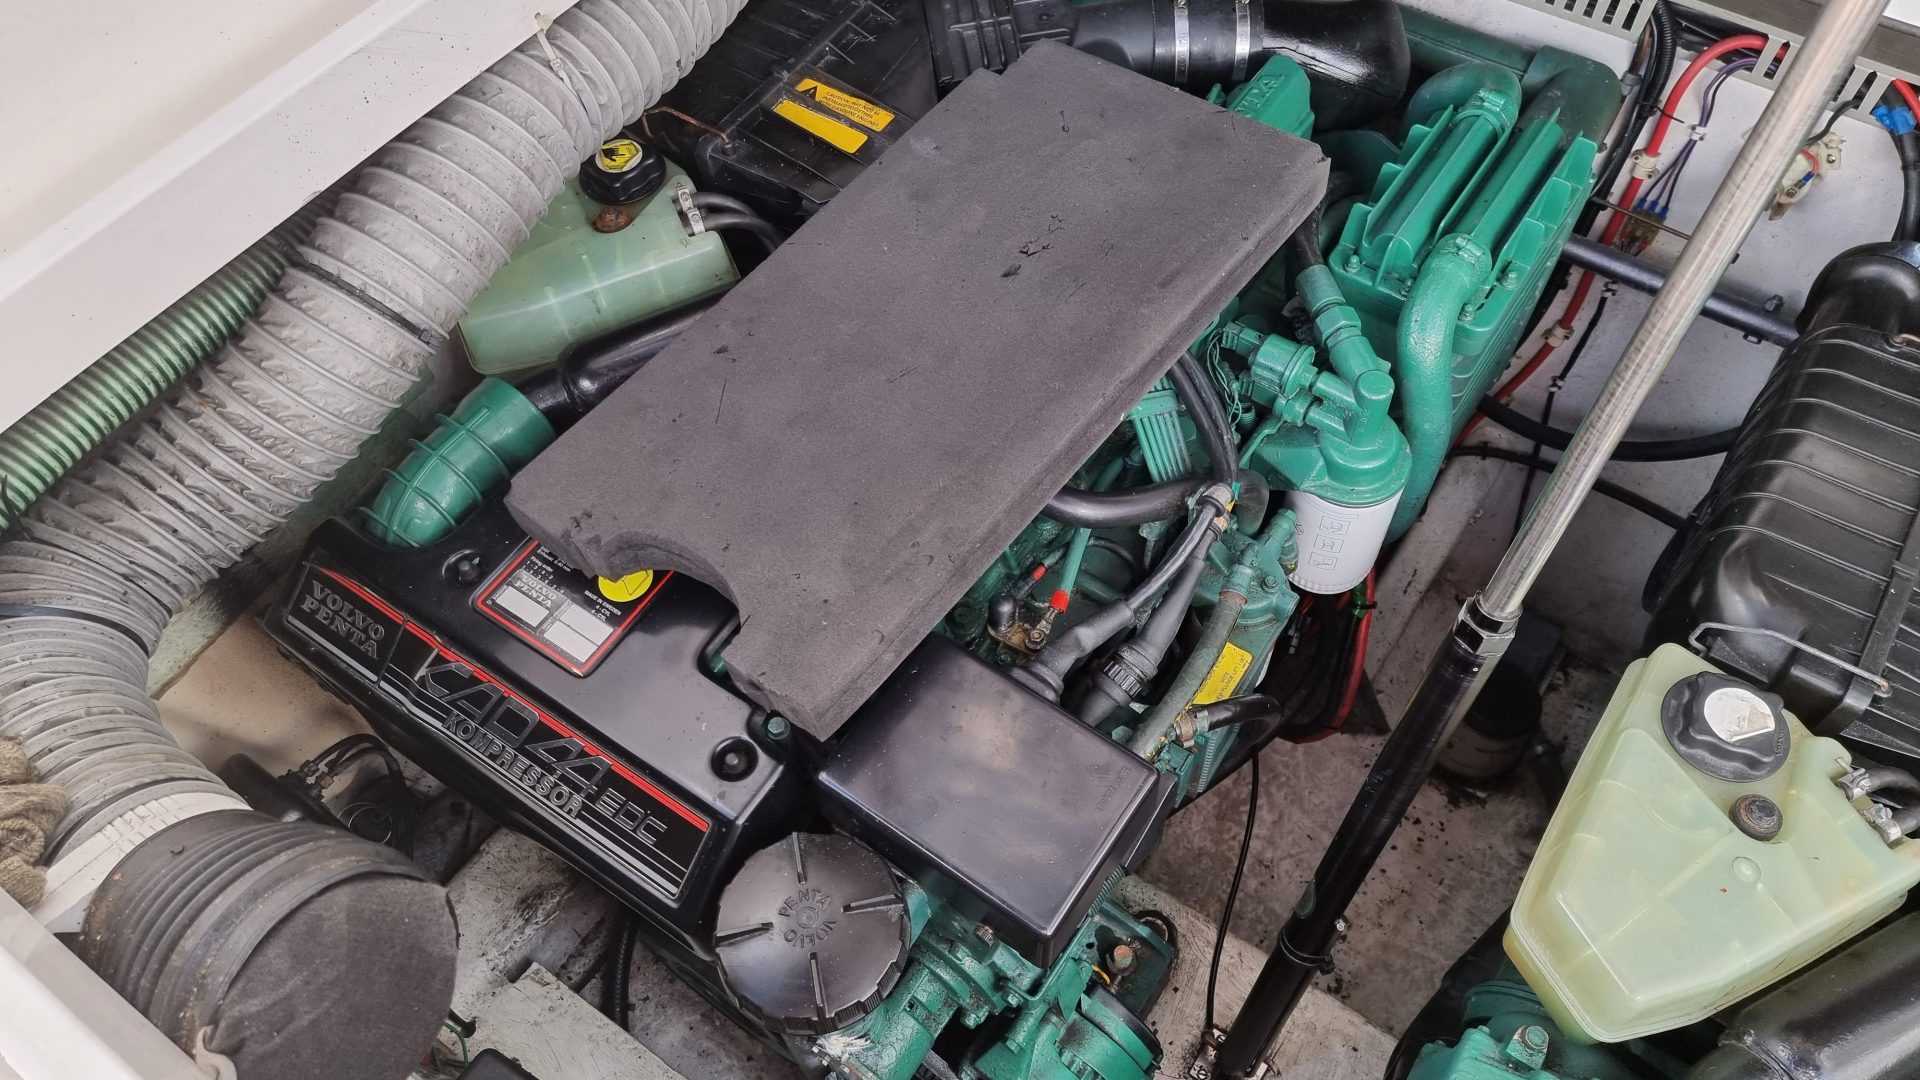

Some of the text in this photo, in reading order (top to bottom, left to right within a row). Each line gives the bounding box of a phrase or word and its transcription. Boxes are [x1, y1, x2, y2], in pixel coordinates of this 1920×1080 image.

[822, 95, 874, 119] INSTALLED TOGETHER
[831, 104, 857, 118] GASOLINE
[856, 113, 880, 127] ENGINES
[862, 105, 875, 114] NOT
[514, 580, 552, 608] PENTA
[523, 575, 557, 600] VOLVO
[312, 580, 385, 640] VOLVO
[584, 590, 598, 601] MADE
[602, 601, 622, 616] SWEDEN
[301, 594, 378, 660] PENTA
[1776, 729, 1785, 757] VOLVO
[443, 709, 583, 819] KOMPRESSOR
[595, 787, 668, 846] EDC
[778, 888, 832, 918] PENTA
[783, 920, 837, 948] VOLVO
